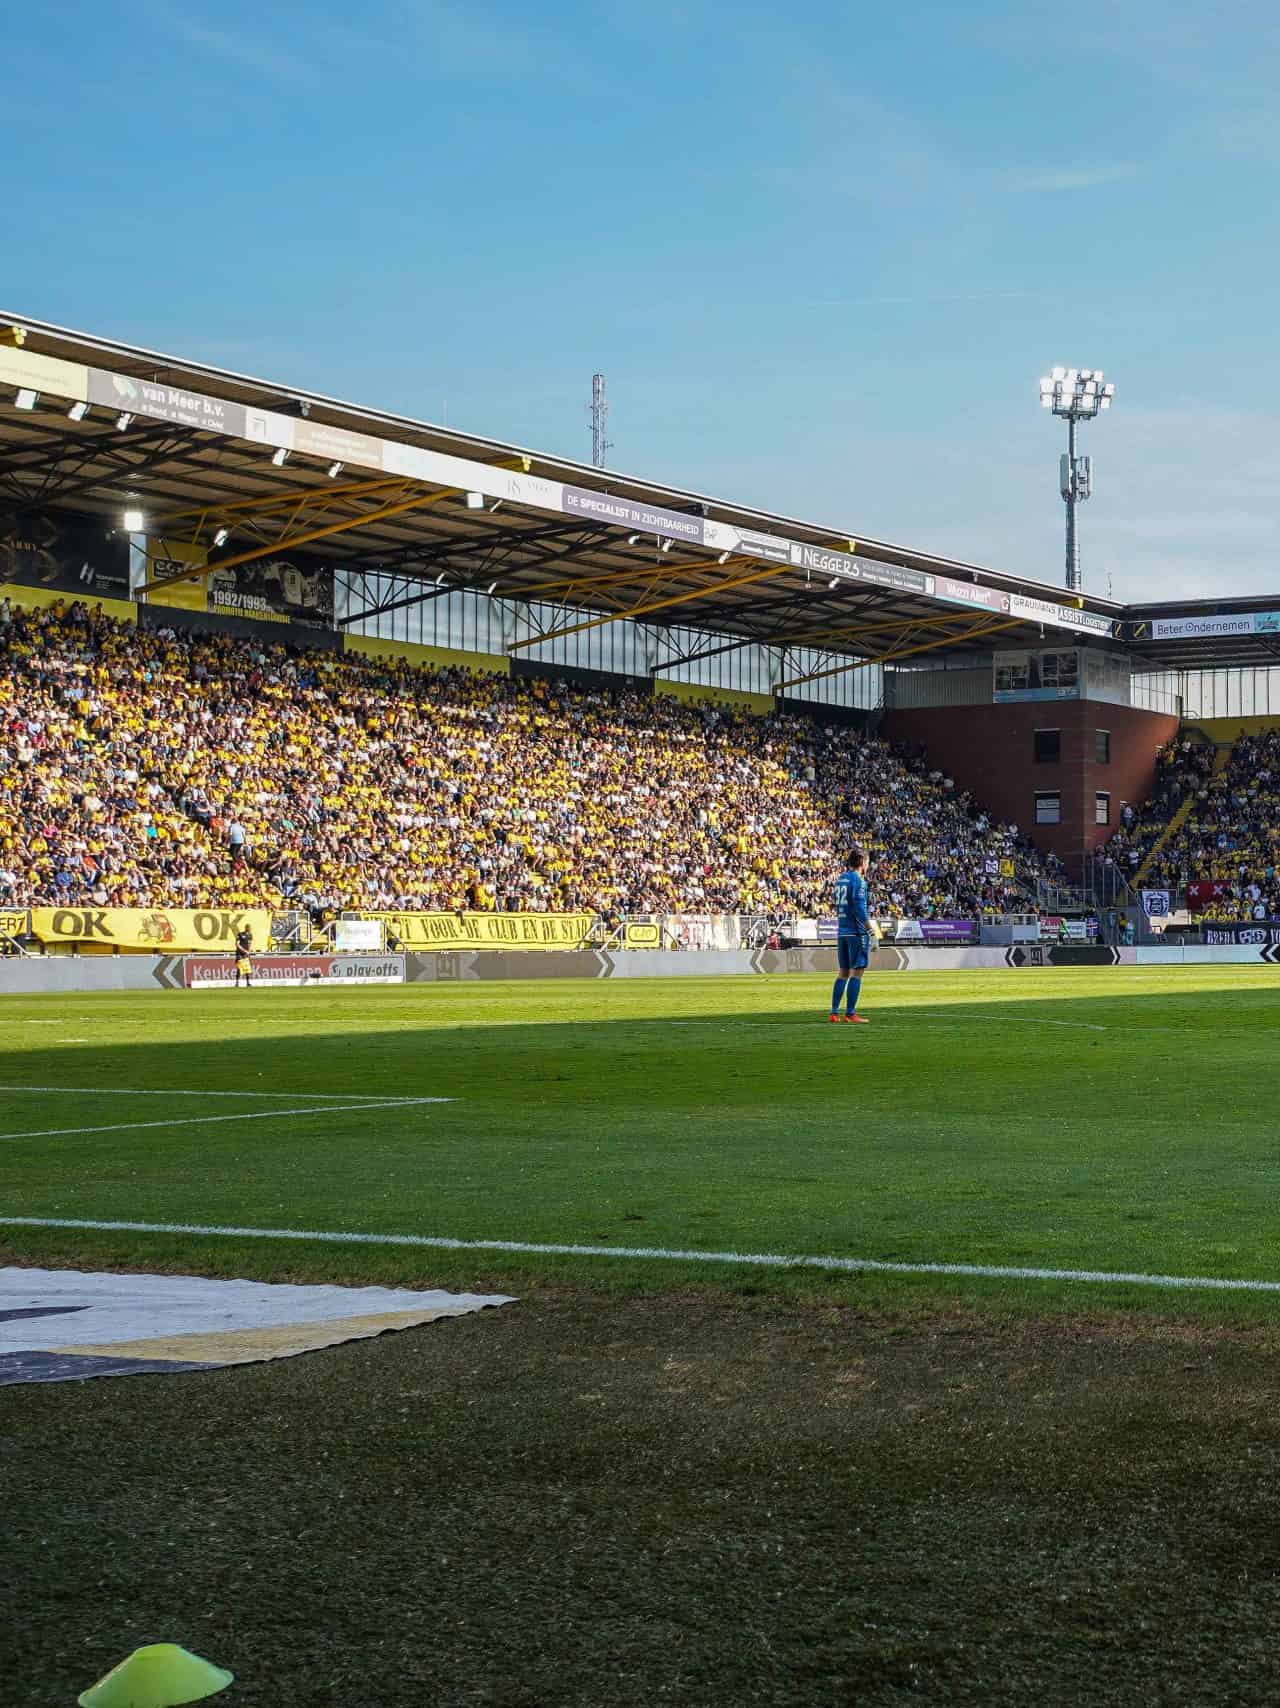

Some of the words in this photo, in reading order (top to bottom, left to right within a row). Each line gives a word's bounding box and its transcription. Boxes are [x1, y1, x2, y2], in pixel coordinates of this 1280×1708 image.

[142, 388, 165, 403] van
[168, 391, 201, 411] Meer
[203, 399, 224, 417] b.v.
[567, 495, 579, 506] DE
[580, 498, 629, 519] SPECIALIST
[631, 510, 640, 521] IN
[641, 513, 700, 535] ZICHTBAARHEID
[804, 547, 860, 577] NEGGERS
[213, 590, 266, 611] 1992/1993
[1157, 623, 1184, 636] Beter
[1186, 620, 1250, 634] Ondernemen
[51, 910, 115, 937] OK
[193, 912, 249, 941] OK
[421, 918, 458, 939] VOOR
[465, 919, 481, 939] DE
[488, 919, 519, 940] CLUB
[522, 919, 538, 940] EN
[543, 920, 558, 940] DE
[193, 964, 238, 980] Keuke
